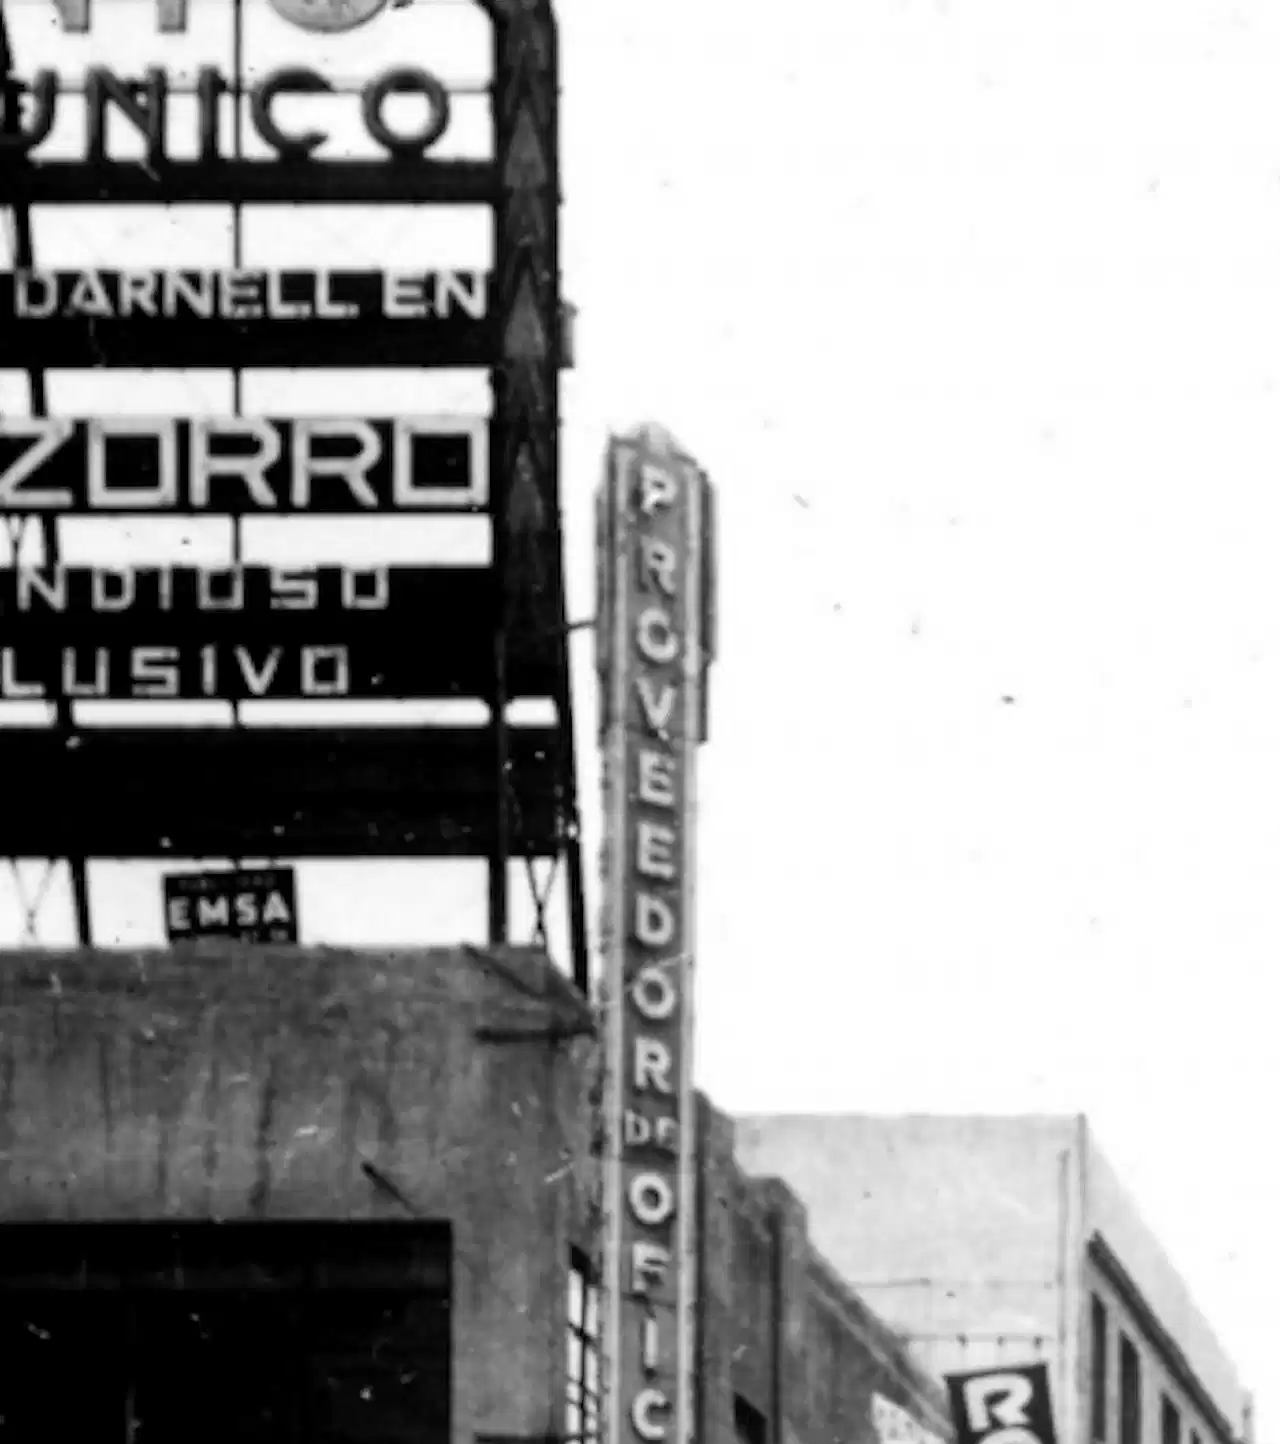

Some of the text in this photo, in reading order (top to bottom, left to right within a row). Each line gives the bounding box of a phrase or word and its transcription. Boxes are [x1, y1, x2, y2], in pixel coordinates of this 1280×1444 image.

[15, 268, 487, 320] DARNELL EN
[0, 416, 490, 507] ZORRO
[17, 564, 390, 611] NDIOSO
[1, 645, 350, 697] LUSIVO
[630, 463, 680, 1093] PROVEEDOR
[168, 888, 291, 931] EMSA
